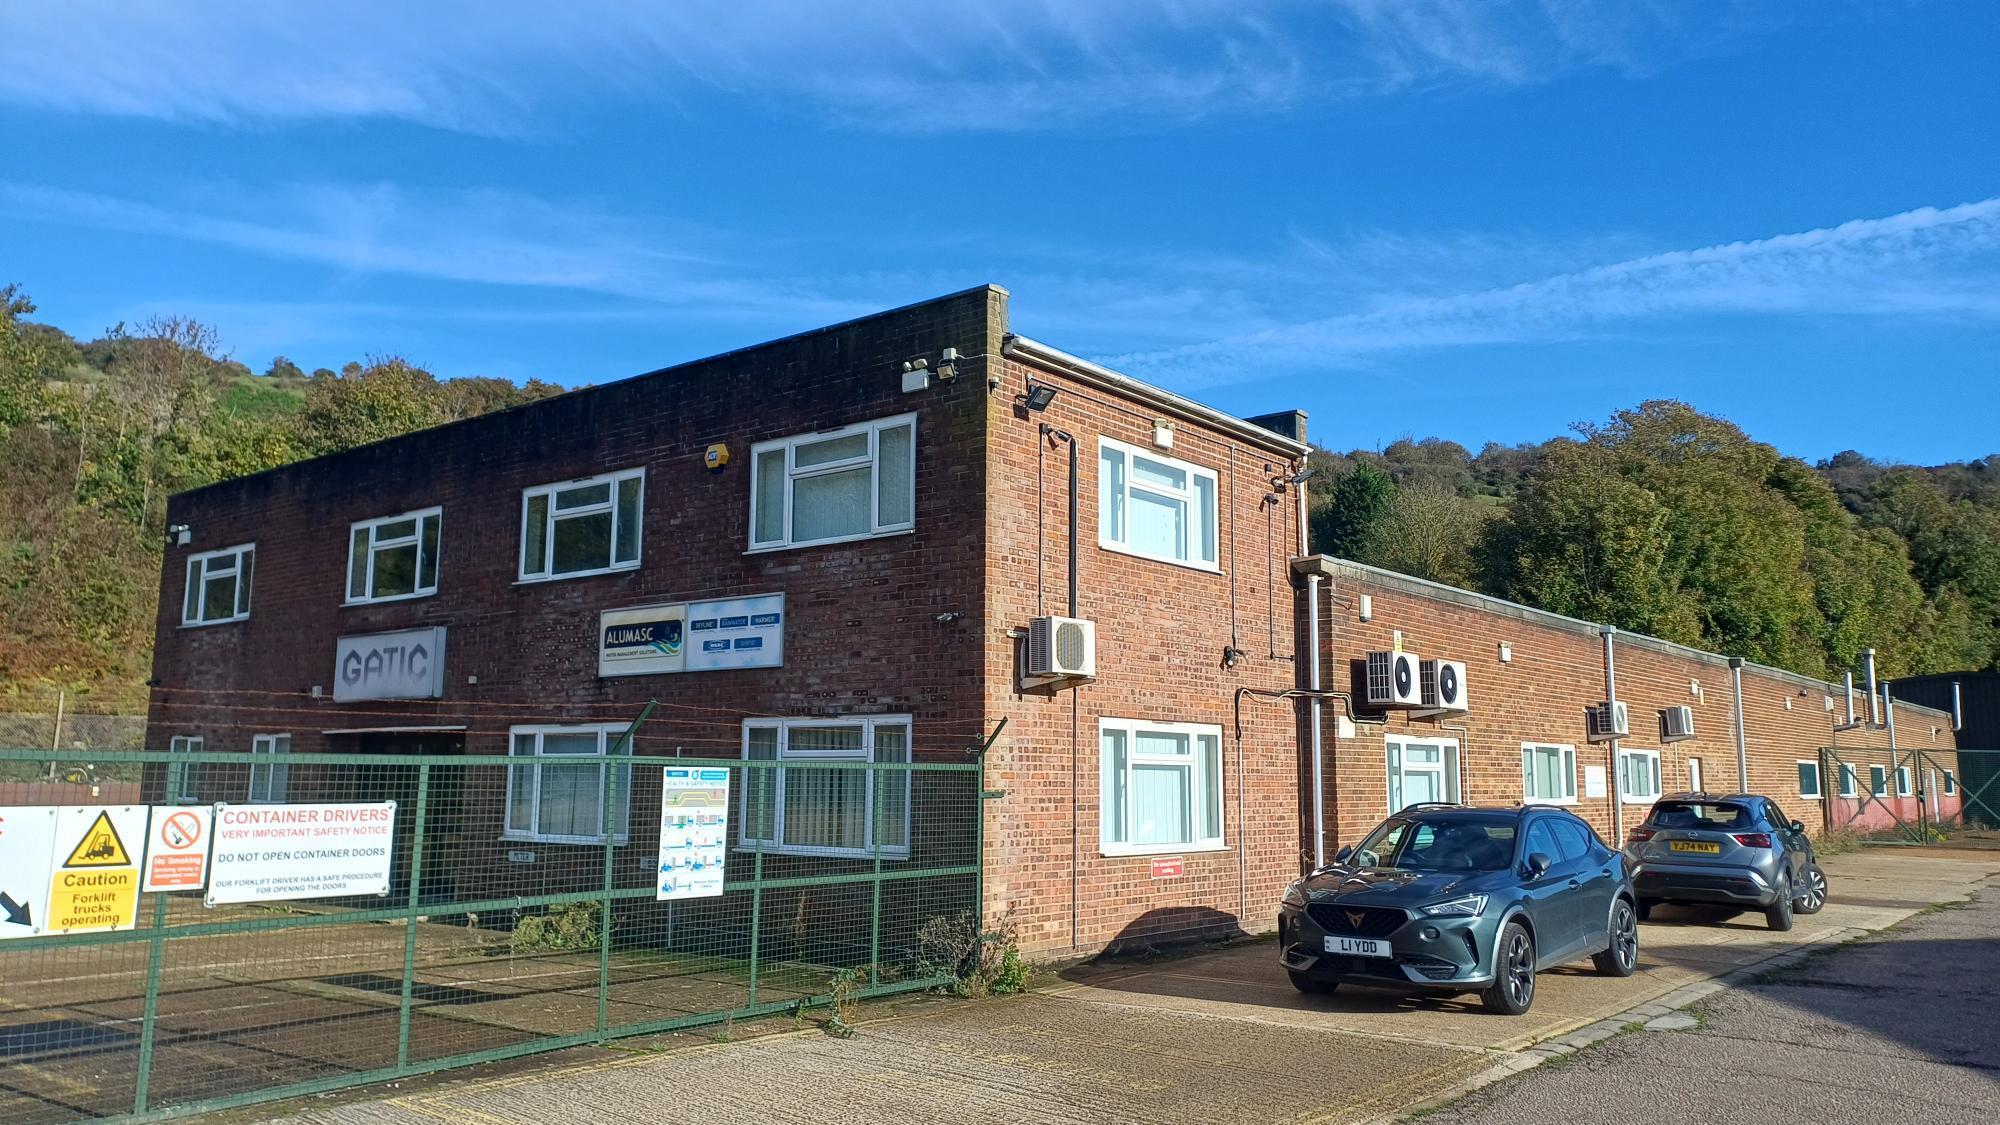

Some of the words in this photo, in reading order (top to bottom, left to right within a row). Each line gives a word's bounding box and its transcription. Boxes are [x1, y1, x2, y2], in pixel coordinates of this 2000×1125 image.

[606, 628, 653, 644] ALUMASC
[342, 643, 428, 687] GATIC
[224, 810, 318, 824] CONTAINER
[324, 809, 388, 822] DRIVERS
[222, 830, 249, 839] VERY
[252, 828, 310, 838] IMPORTANT
[314, 827, 351, 836] SAFETY
[353, 826, 388, 835] NOTICE
[1673, 841, 1695, 850] YJ74
[1697, 842, 1716, 851] NAY
[154, 857, 166, 865] No
[168, 856, 201, 865] Smoking
[218, 854, 234, 862] DO
[237, 853, 259, 861] NOT
[262, 851, 290, 861] OPEN
[294, 849, 349, 859] CONTAINER
[352, 848, 385, 857] DOORS
[64, 873, 127, 887] Caution
[234, 878, 270, 886] FORKLIFT
[272, 877, 299, 885] DRIVER
[342, 872, 383, 881] PROCEDURE
[73, 892, 116, 903] Forklift
[74, 904, 112, 914] trucks
[61, 914, 120, 927] operating
